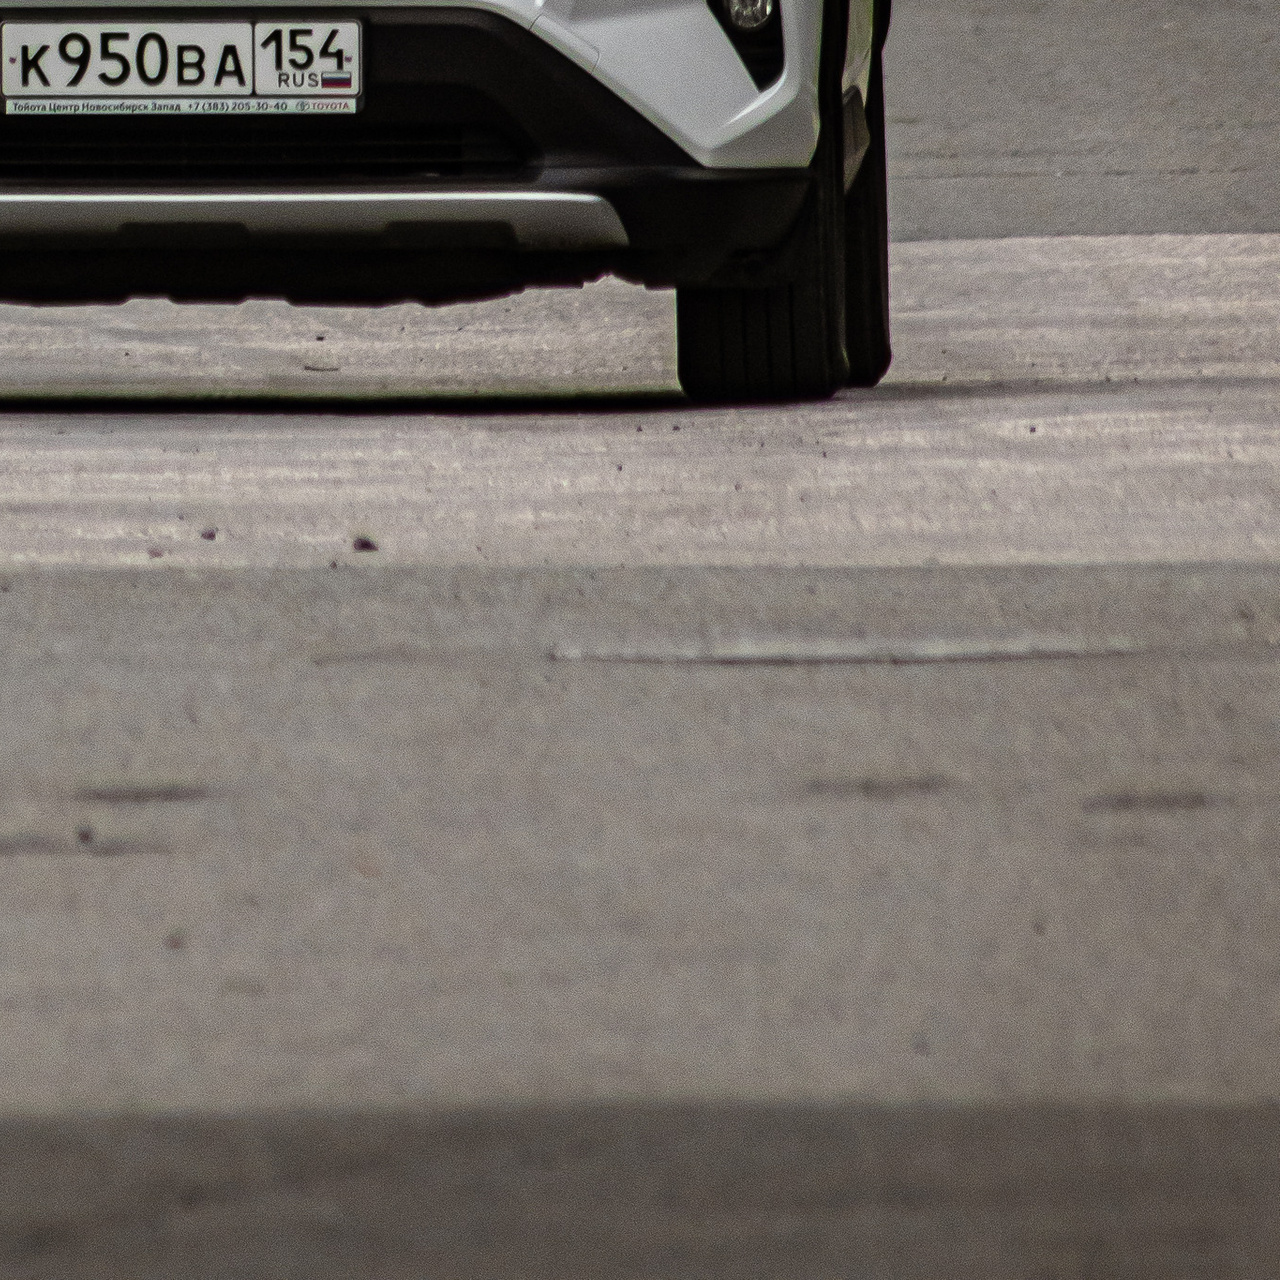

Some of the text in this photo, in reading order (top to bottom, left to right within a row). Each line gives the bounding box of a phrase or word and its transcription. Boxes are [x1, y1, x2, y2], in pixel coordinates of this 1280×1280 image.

[21, 29, 344, 88] К950ВА 154
[277, 72, 319, 88] RUS
[13, 101, 349, 113] Тойота Центр Новосибирск Запад +7 (383) 205-30-40 TOYOTA
